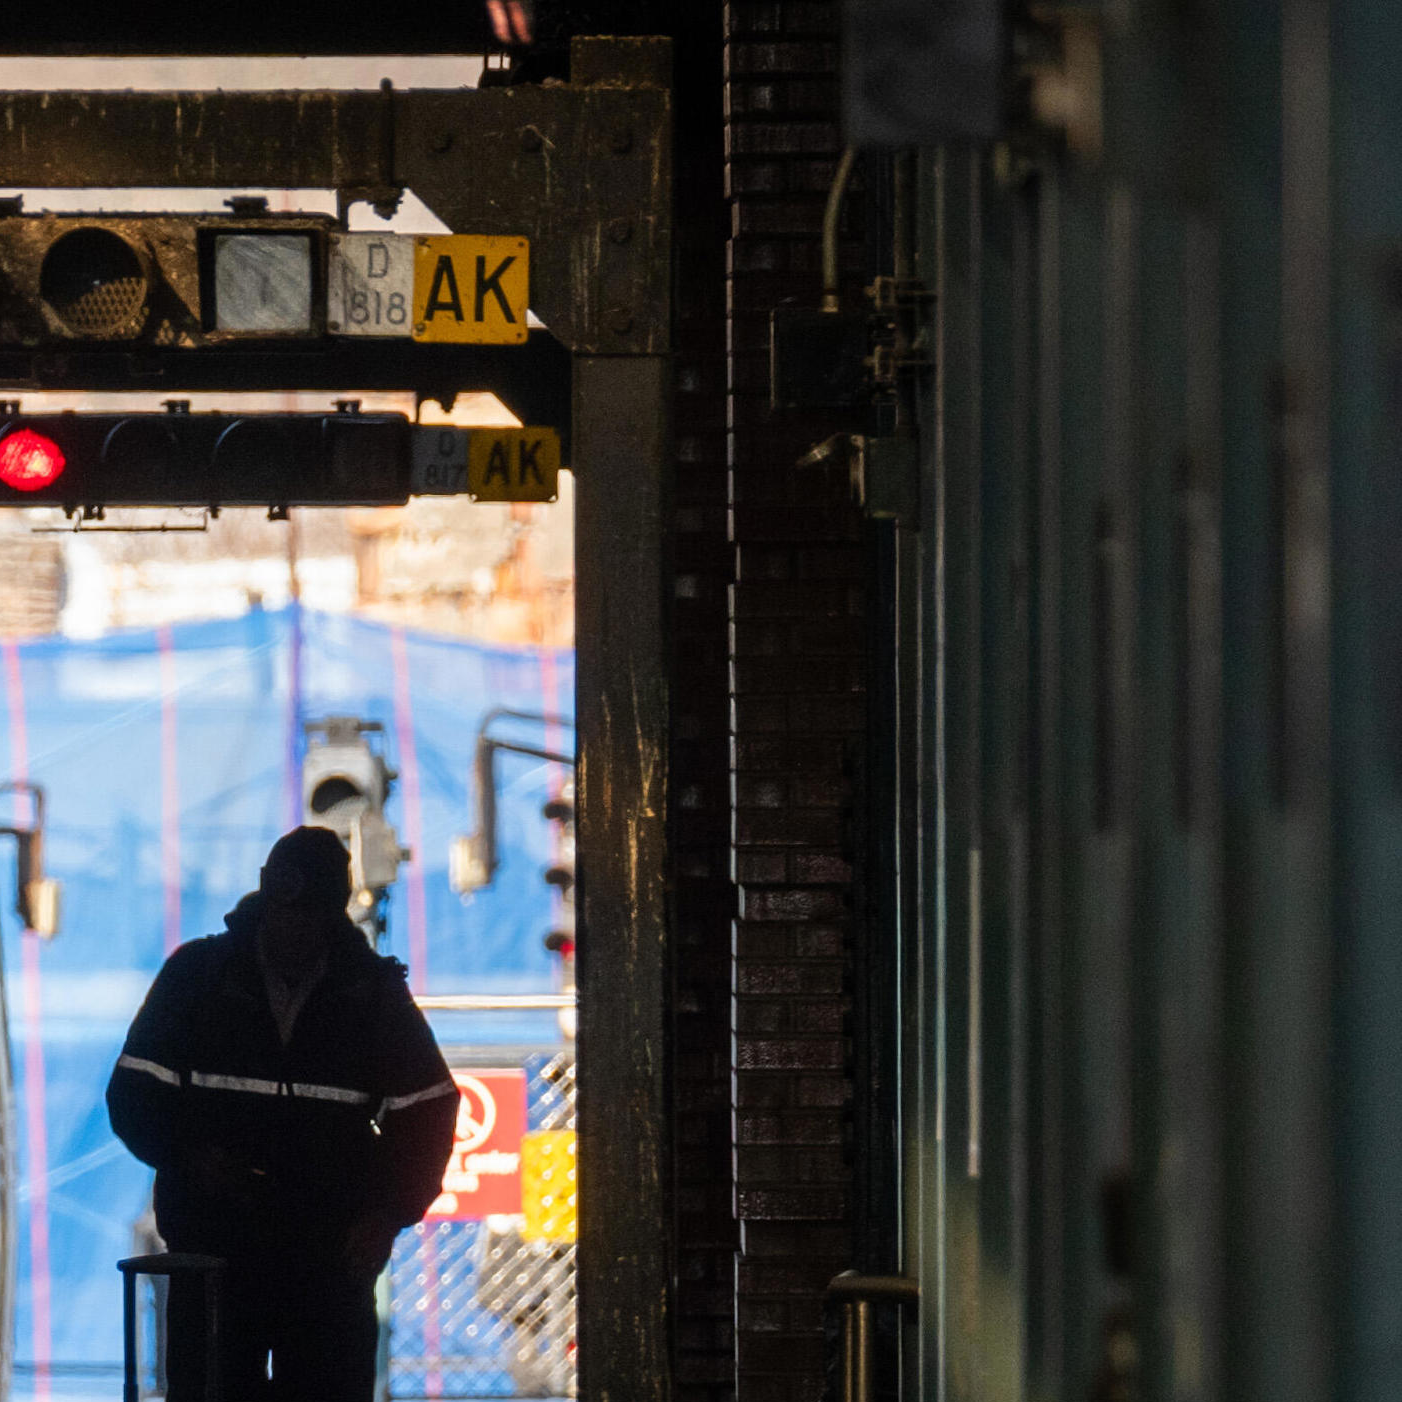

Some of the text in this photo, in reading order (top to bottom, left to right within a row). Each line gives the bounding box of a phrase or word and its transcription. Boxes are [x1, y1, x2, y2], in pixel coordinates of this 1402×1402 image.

[367, 243, 389, 278] D
[349, 290, 407, 325] 818
[423, 255, 518, 323] AK
[483, 439, 543, 486] AK
